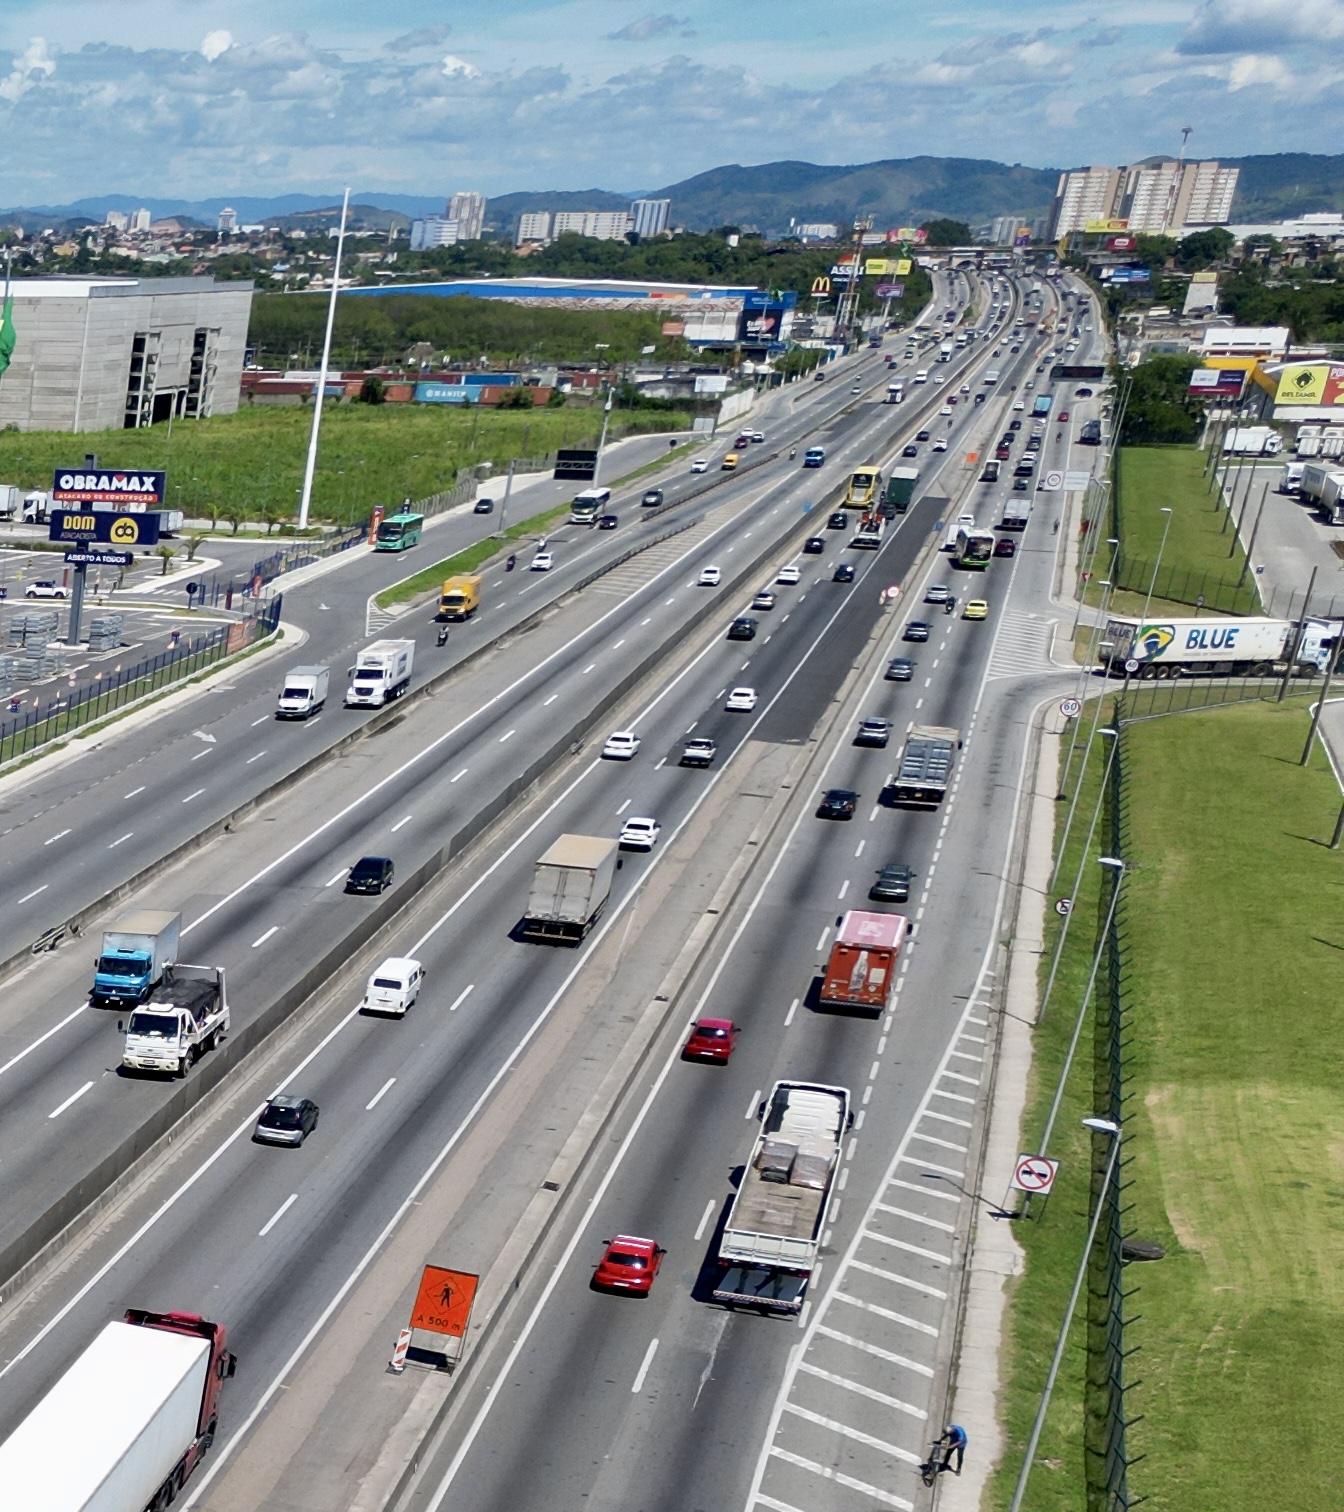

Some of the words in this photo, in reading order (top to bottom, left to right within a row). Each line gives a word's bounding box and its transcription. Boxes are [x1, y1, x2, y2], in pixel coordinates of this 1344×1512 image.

[59, 474, 156, 491] OBRAMAX
[63, 516, 96, 530] DOM
[60, 531, 97, 540] ATACADISTA
[67, 553, 94, 562] ABERTO
[102, 555, 126, 563] TODOS
[1108, 625, 1131, 639] BLUE
[1185, 628, 1240, 650] BLUE
[416, 1314, 424, 1322] A
[428, 1316, 449, 1327] 500
[451, 1323, 461, 1331] m
